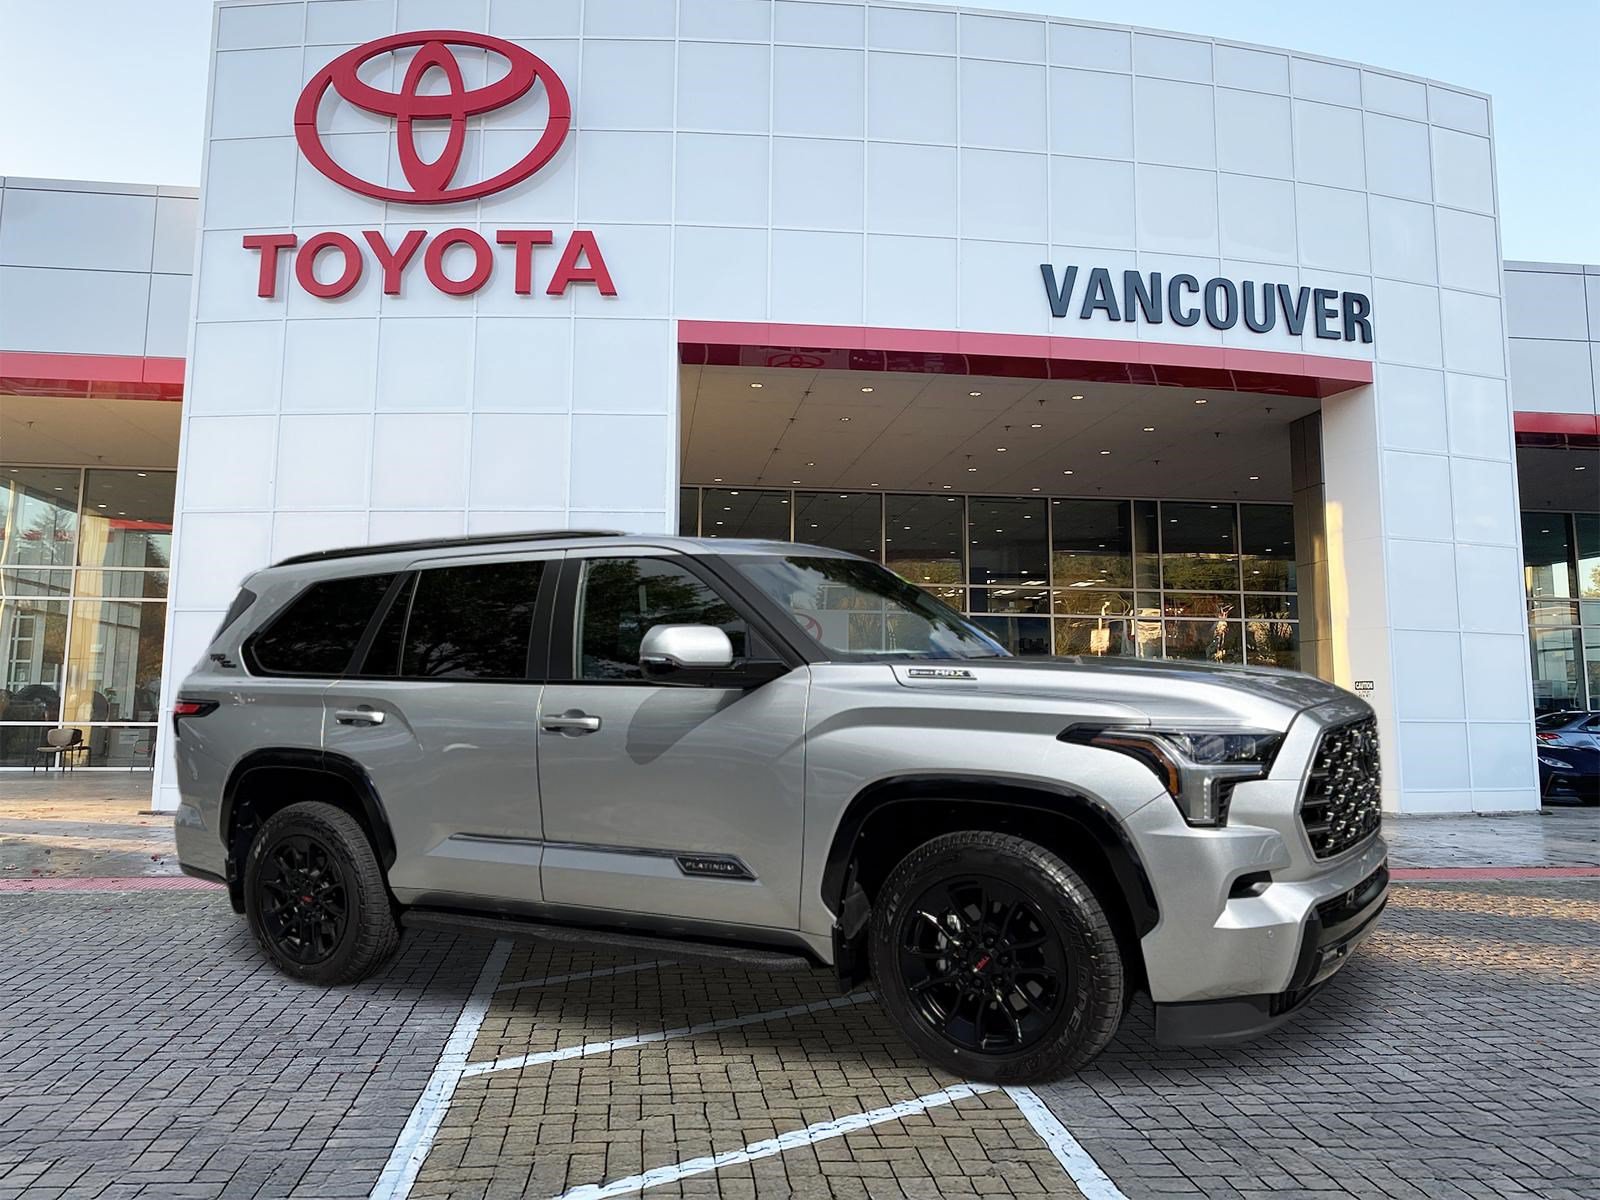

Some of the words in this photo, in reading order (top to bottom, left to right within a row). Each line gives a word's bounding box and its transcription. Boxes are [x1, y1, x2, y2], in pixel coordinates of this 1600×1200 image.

[243, 227, 618, 298] TOYOTA
[1040, 263, 1373, 343] VANCOUVER
[685, 861, 735, 871] PLATINUM
